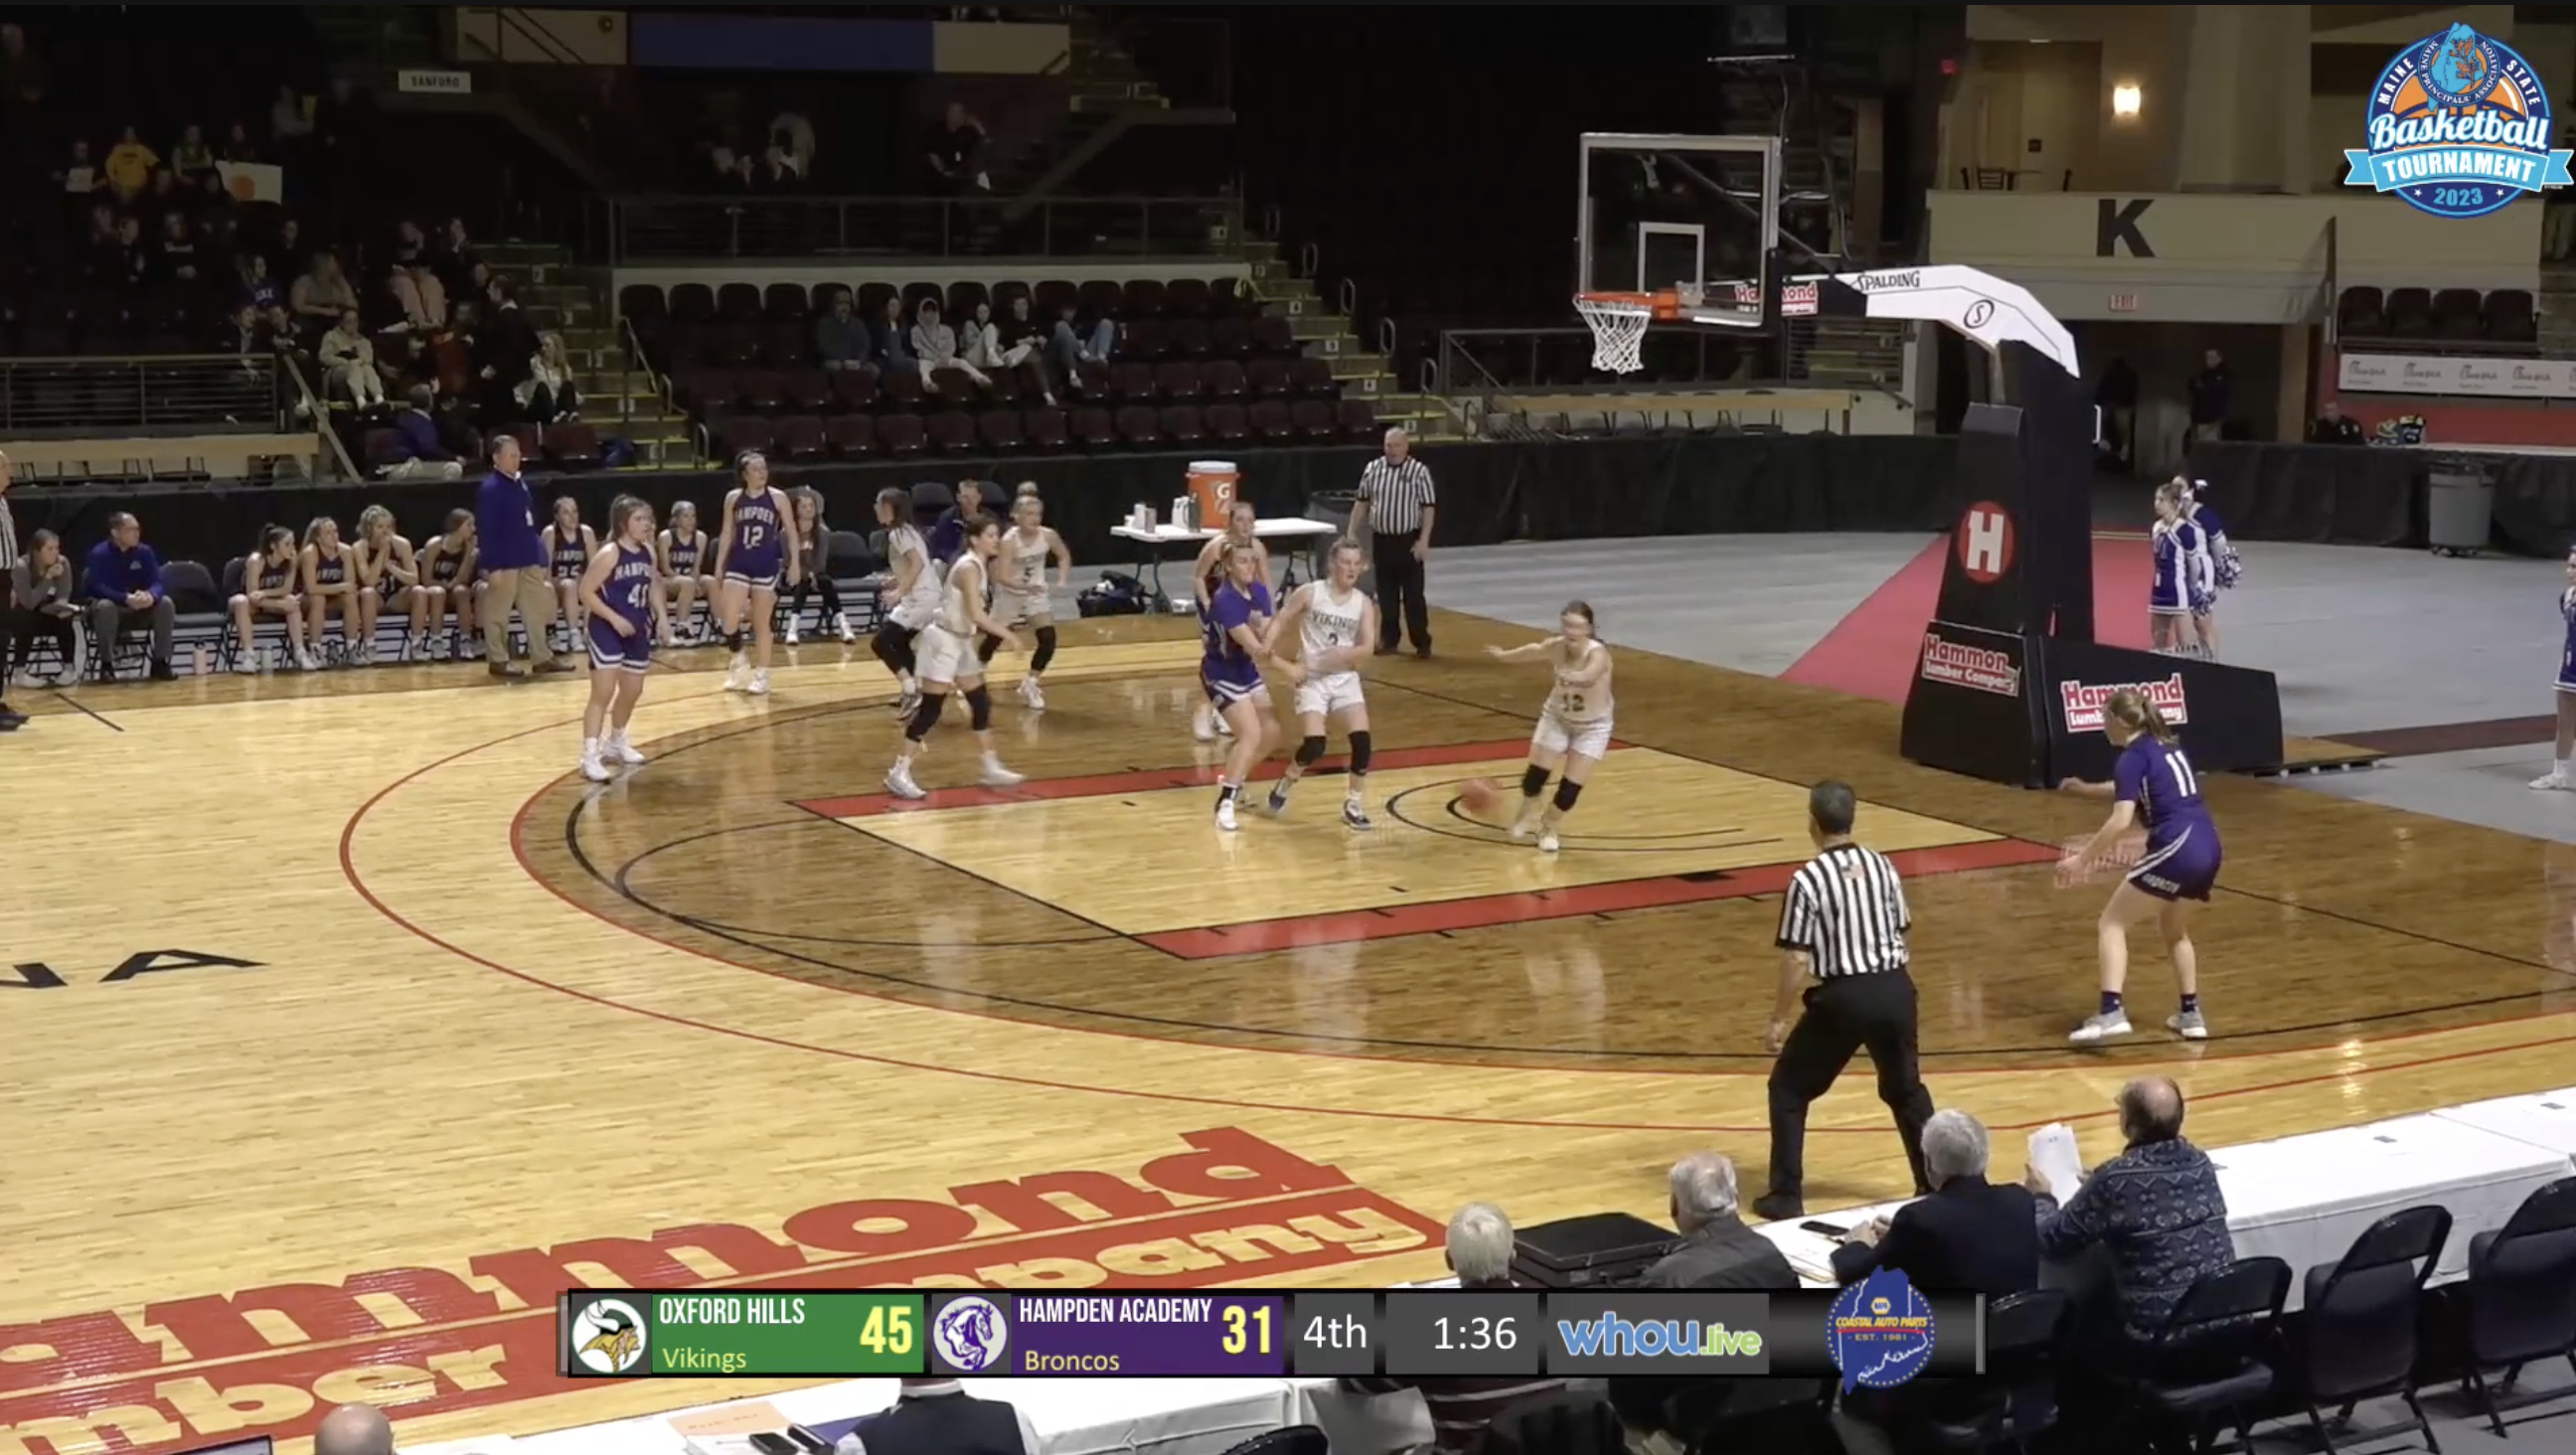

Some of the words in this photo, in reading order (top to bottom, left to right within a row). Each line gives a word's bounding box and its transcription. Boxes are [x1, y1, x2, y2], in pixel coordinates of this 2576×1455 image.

[2096, 199, 2157, 257] K
[1854, 270, 1920, 291] SPALDING
[1216, 482, 1231, 499] G
[742, 526, 763, 549] 12
[1966, 510, 2005, 573] H
[1926, 634, 2009, 672] Hammon
[2165, 749, 2197, 797] 11
